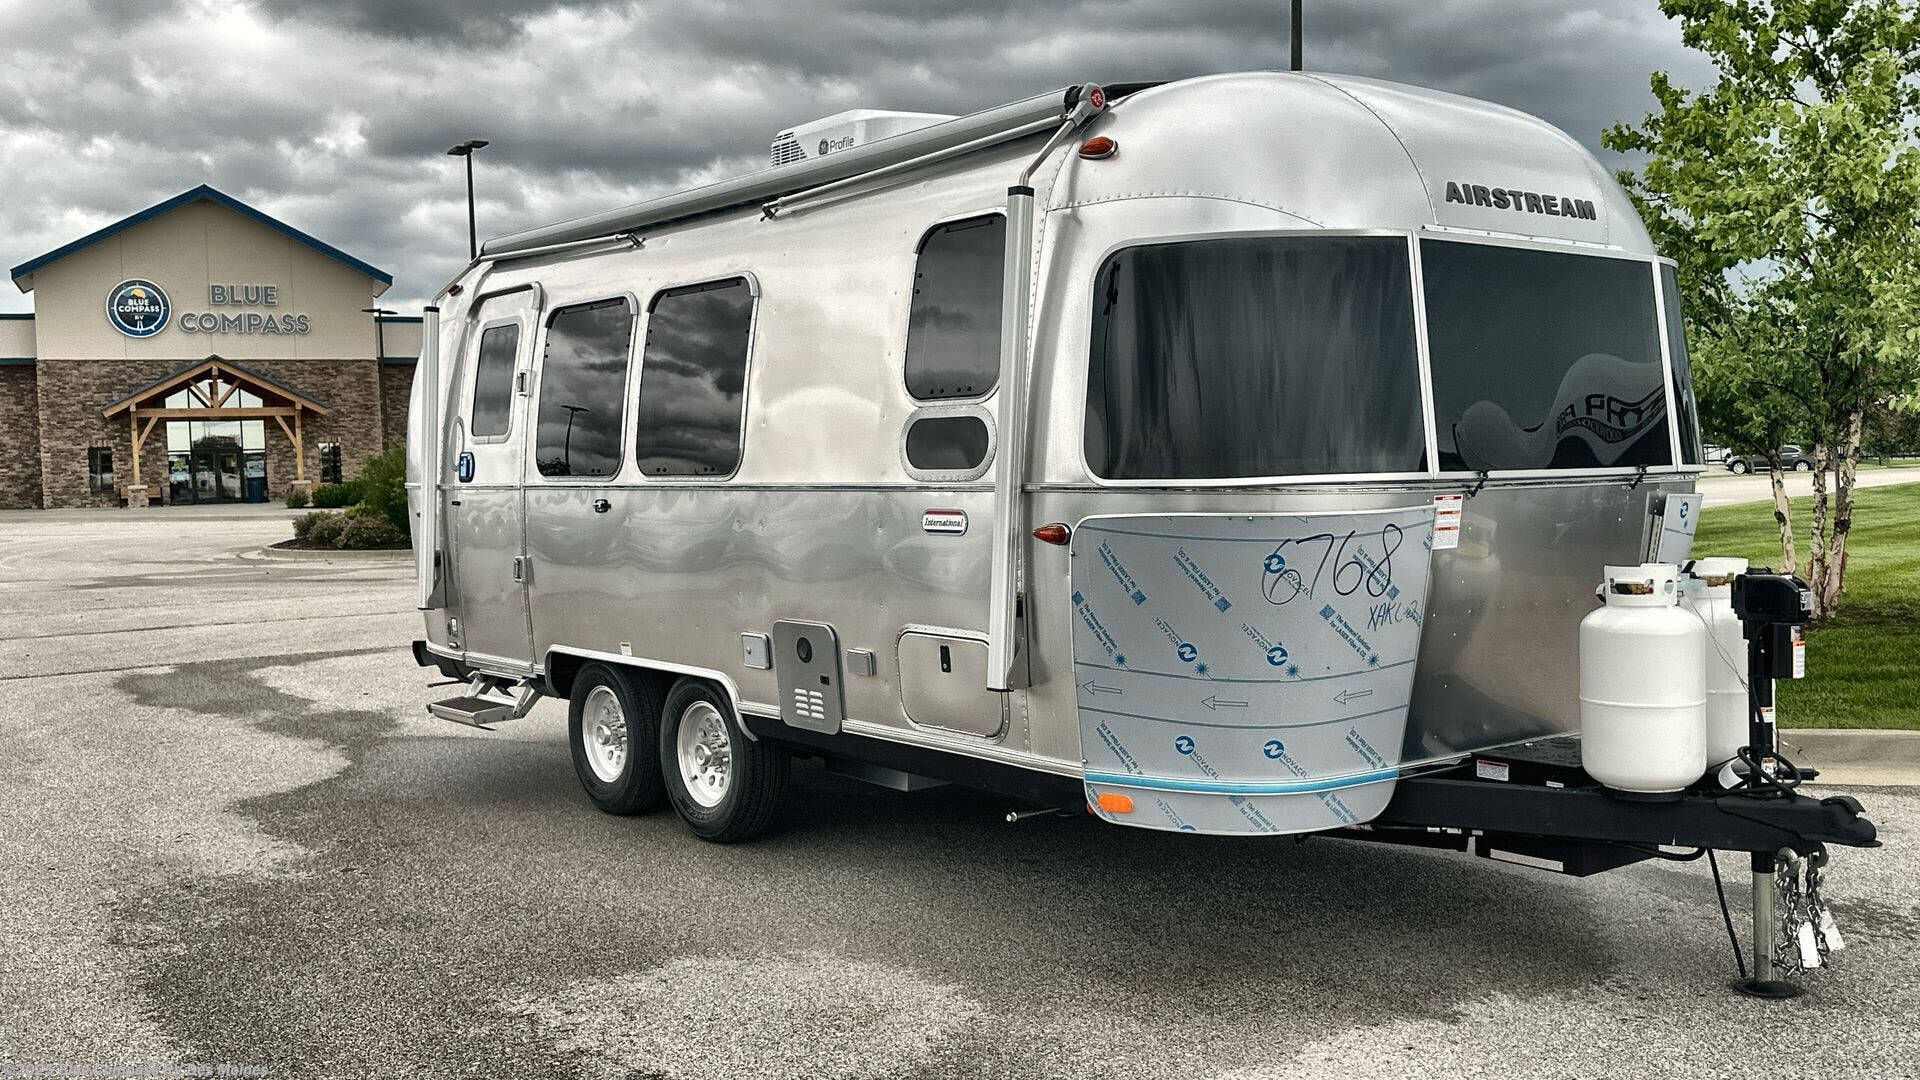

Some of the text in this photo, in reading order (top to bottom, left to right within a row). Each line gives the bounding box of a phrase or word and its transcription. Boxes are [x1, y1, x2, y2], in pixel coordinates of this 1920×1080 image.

[830, 136, 854, 151] Profile
[1446, 182, 1597, 220] AIRSTREAM
[209, 283, 278, 306] BLUE
[118, 305, 160, 313] COMPASS
[178, 312, 311, 335] COMPASS
[924, 517, 964, 527] International
[1262, 523, 1403, 605] 6768
[1153, 616, 1180, 647] NOVACEL
[1240, 623, 1269, 652] NOVACEL
[1192, 750, 1220, 780] NOVACEL
[1281, 753, 1309, 780] NOVACEL
[1155, 798, 1182, 828] NOVACEL
